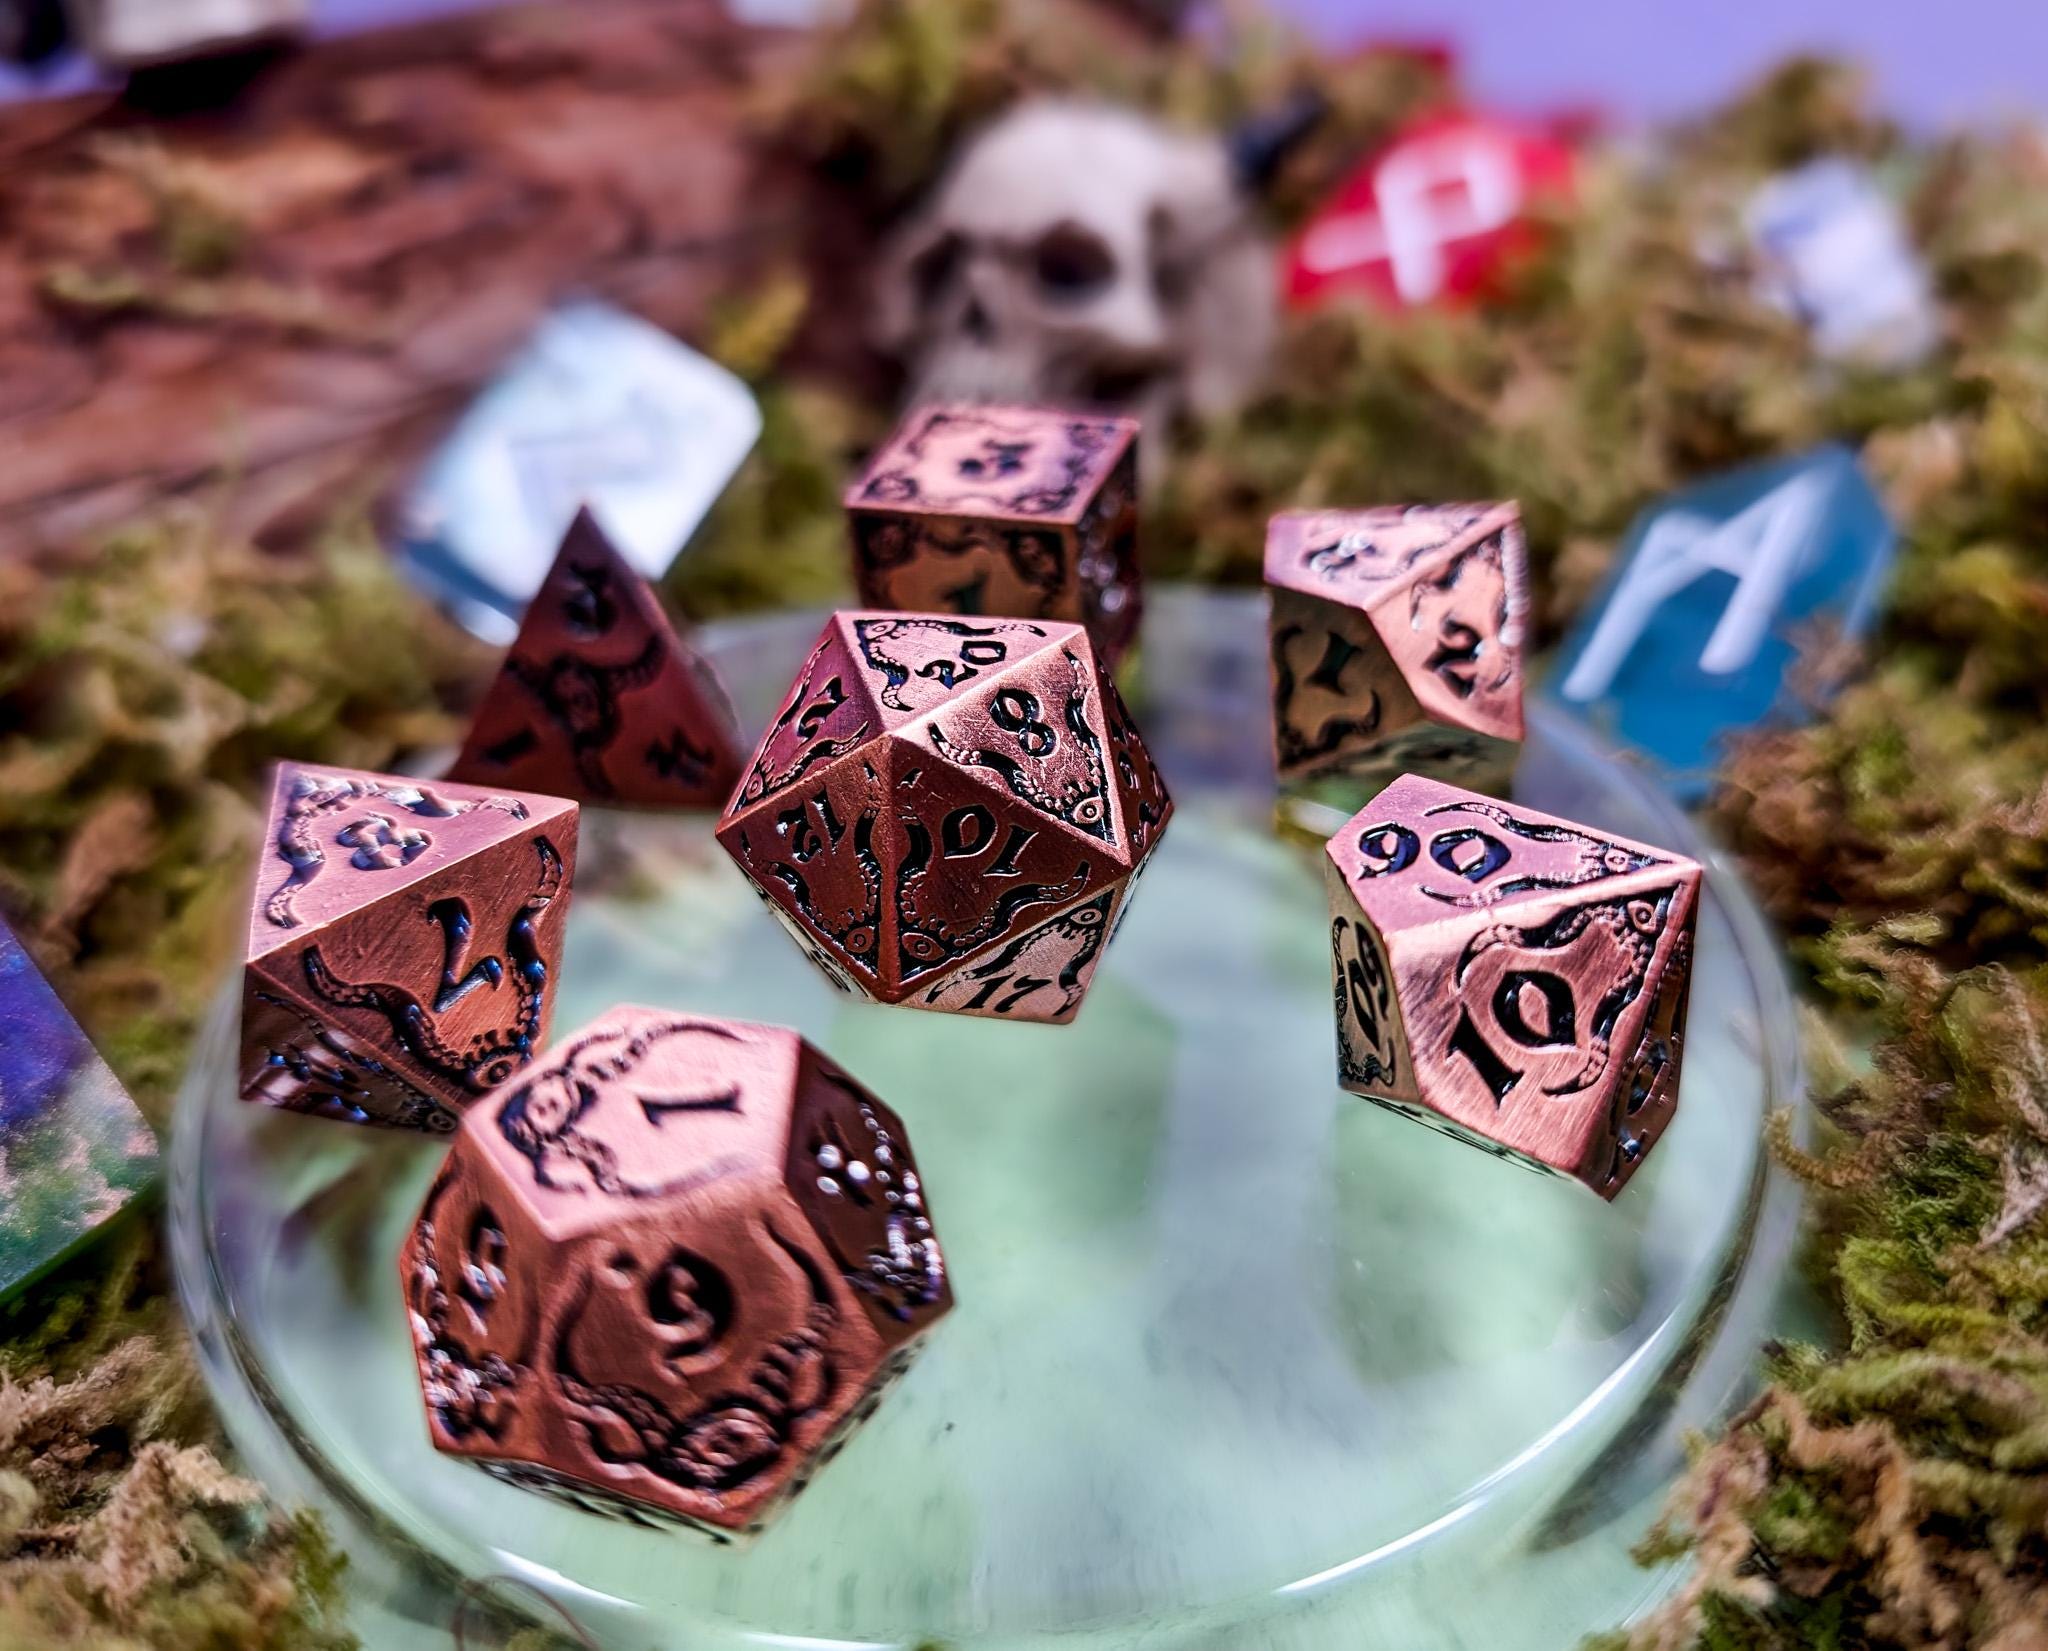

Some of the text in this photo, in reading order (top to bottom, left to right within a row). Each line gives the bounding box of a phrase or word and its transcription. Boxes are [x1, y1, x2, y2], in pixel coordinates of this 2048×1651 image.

[916, 640, 1007, 689] 20
[796, 675, 849, 741] 2
[990, 688, 1057, 757] 8
[778, 789, 846, 864] 12
[942, 805, 1039, 877] 10
[1358, 822, 1512, 884] 90
[958, 973, 1053, 1013] 17
[1445, 970, 1577, 1111] 10
[637, 1083, 744, 1127] 1
